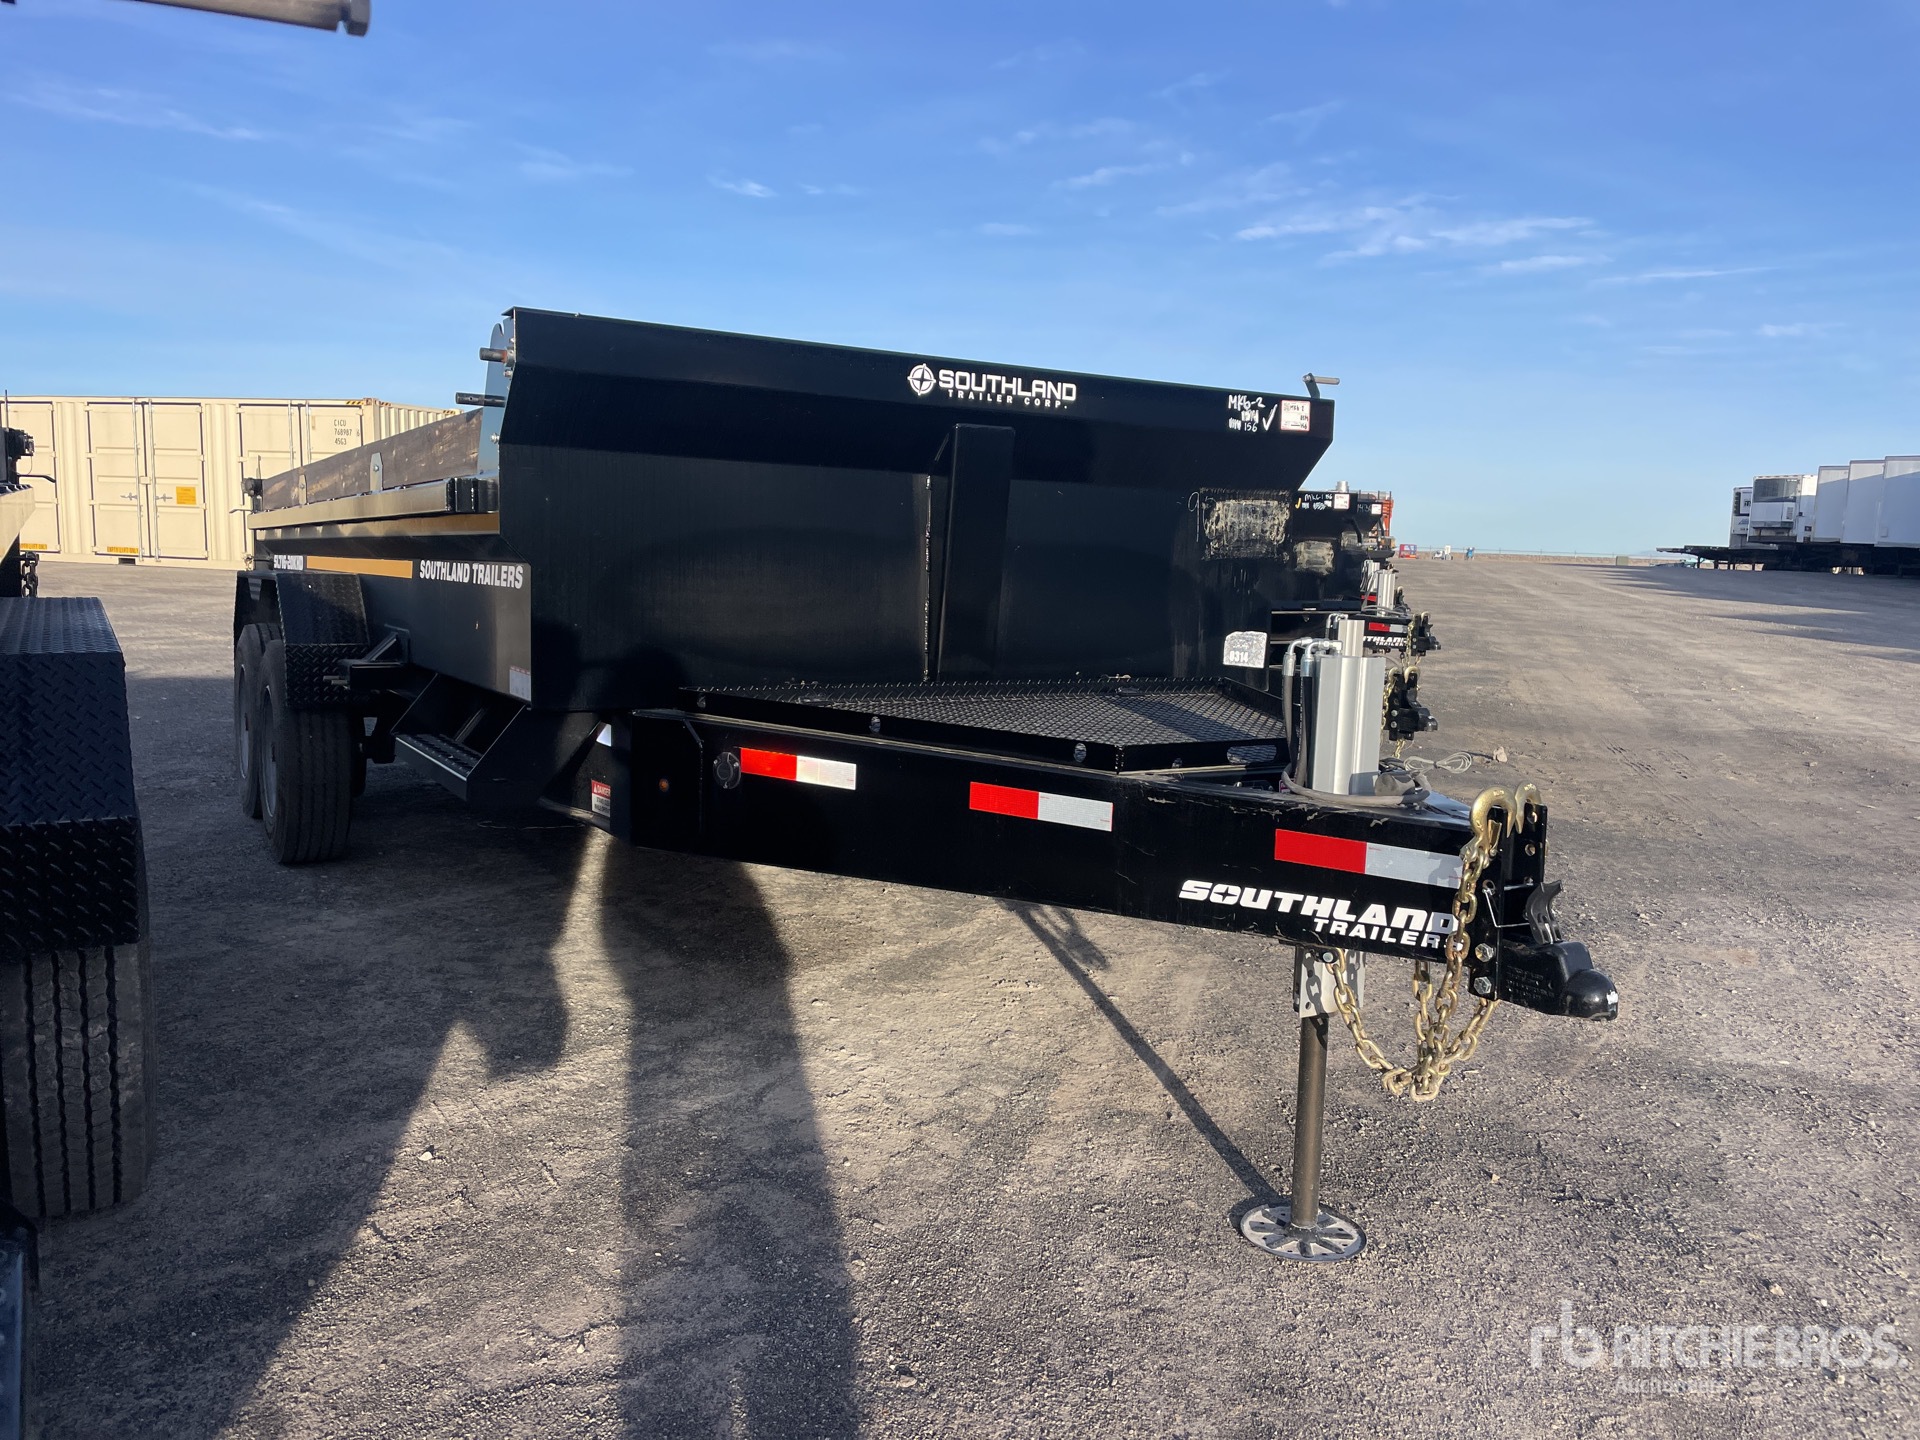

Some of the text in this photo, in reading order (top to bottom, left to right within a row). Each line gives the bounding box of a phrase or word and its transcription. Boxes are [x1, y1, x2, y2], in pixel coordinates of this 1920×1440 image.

[938, 369, 1077, 401] SOUTHLAND
[948, 389, 1068, 409] TRAILER CORP.
[333, 419, 347, 427] CICU
[419, 559, 523, 589] SOUTHLAND TRAILERS
[1178, 879, 1460, 935] SOUTHLAND
